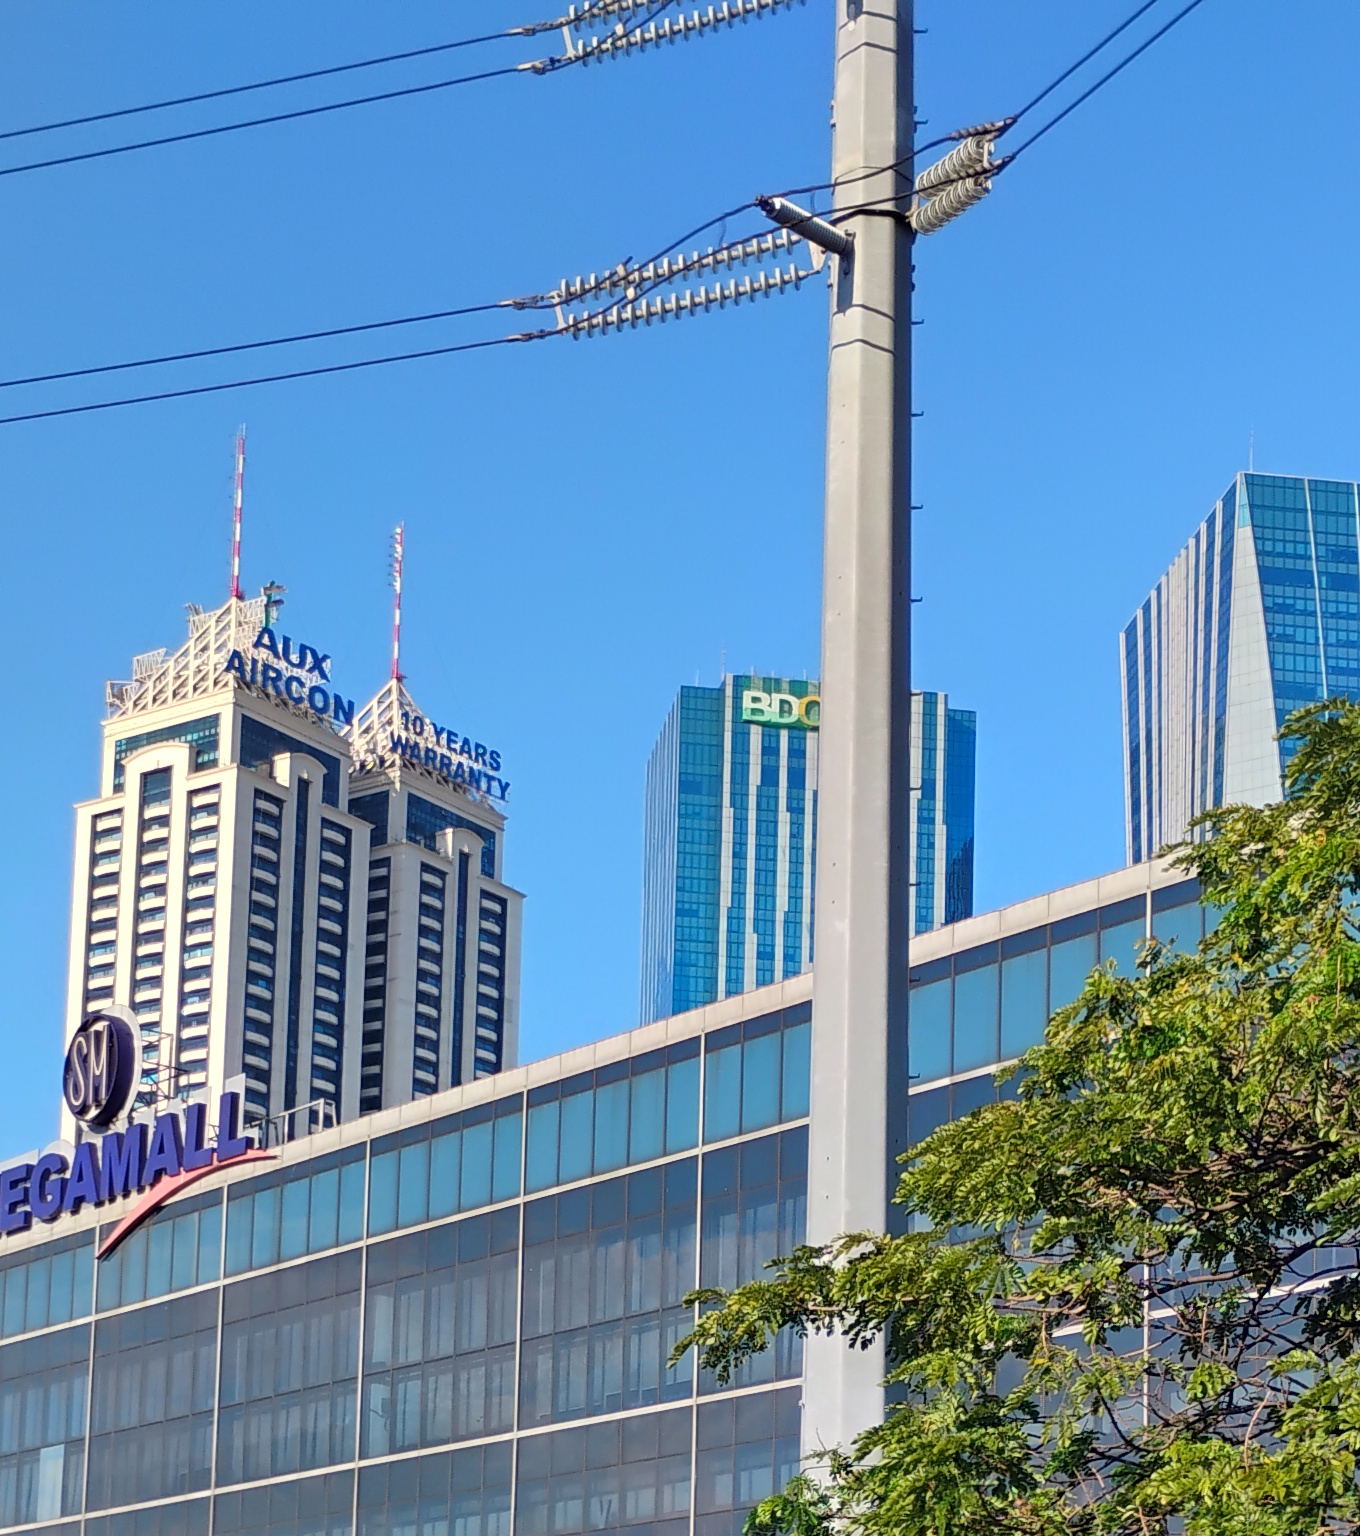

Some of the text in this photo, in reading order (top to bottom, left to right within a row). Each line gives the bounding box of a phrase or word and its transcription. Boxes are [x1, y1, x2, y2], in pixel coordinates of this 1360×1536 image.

[224, 649, 355, 727] AIRCON
[252, 626, 331, 683] AUX
[390, 731, 511, 801] WARRANTY
[400, 710, 502, 772] 10 YEARS
[68, 1022, 112, 1108] SM
